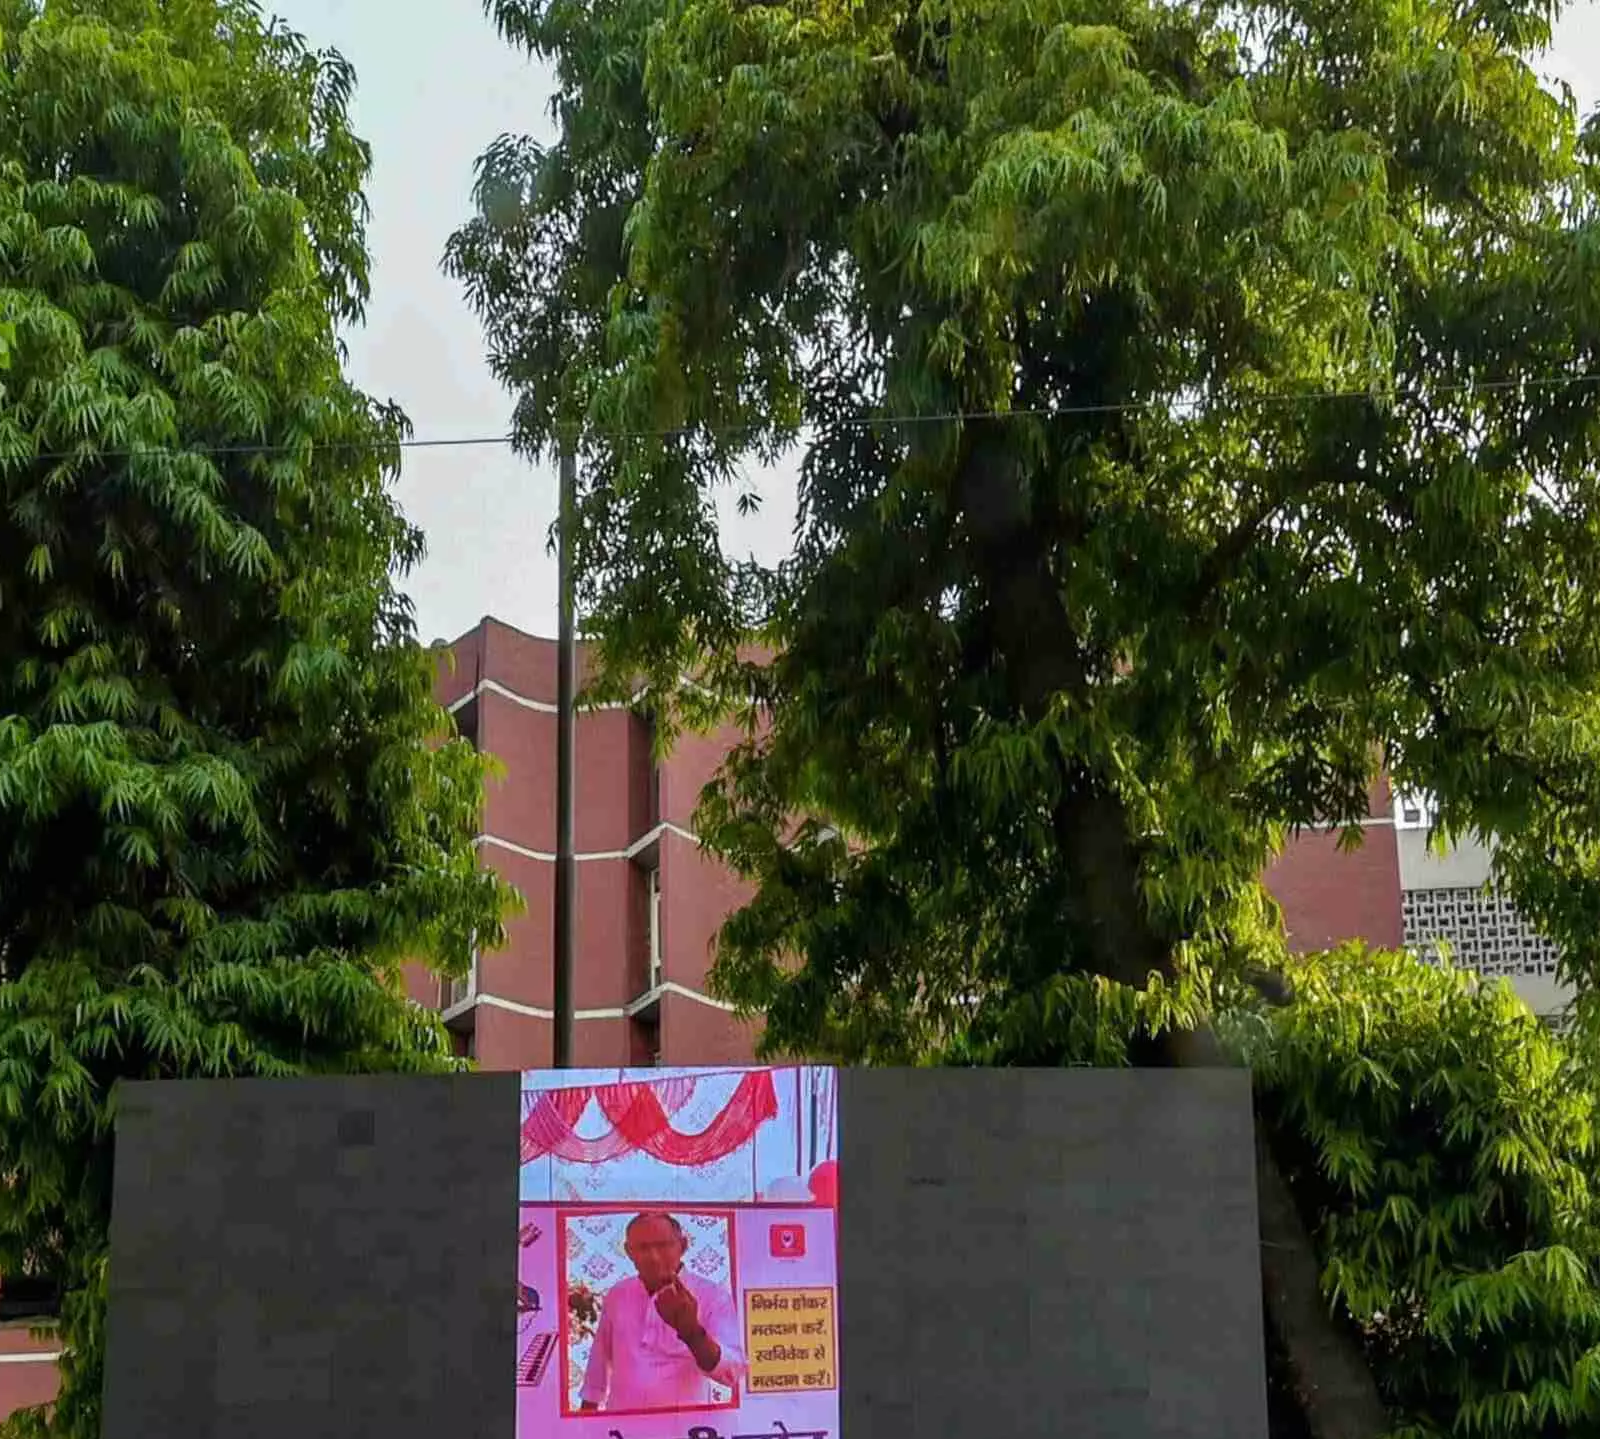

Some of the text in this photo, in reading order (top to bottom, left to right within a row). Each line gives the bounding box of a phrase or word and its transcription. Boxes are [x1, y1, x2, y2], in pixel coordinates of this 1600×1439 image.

[791, 1294, 828, 1311] होकर
[751, 1323, 797, 1336] मतदान
[813, 1345, 826, 1361] से
[752, 1374, 799, 1387] मतदान
